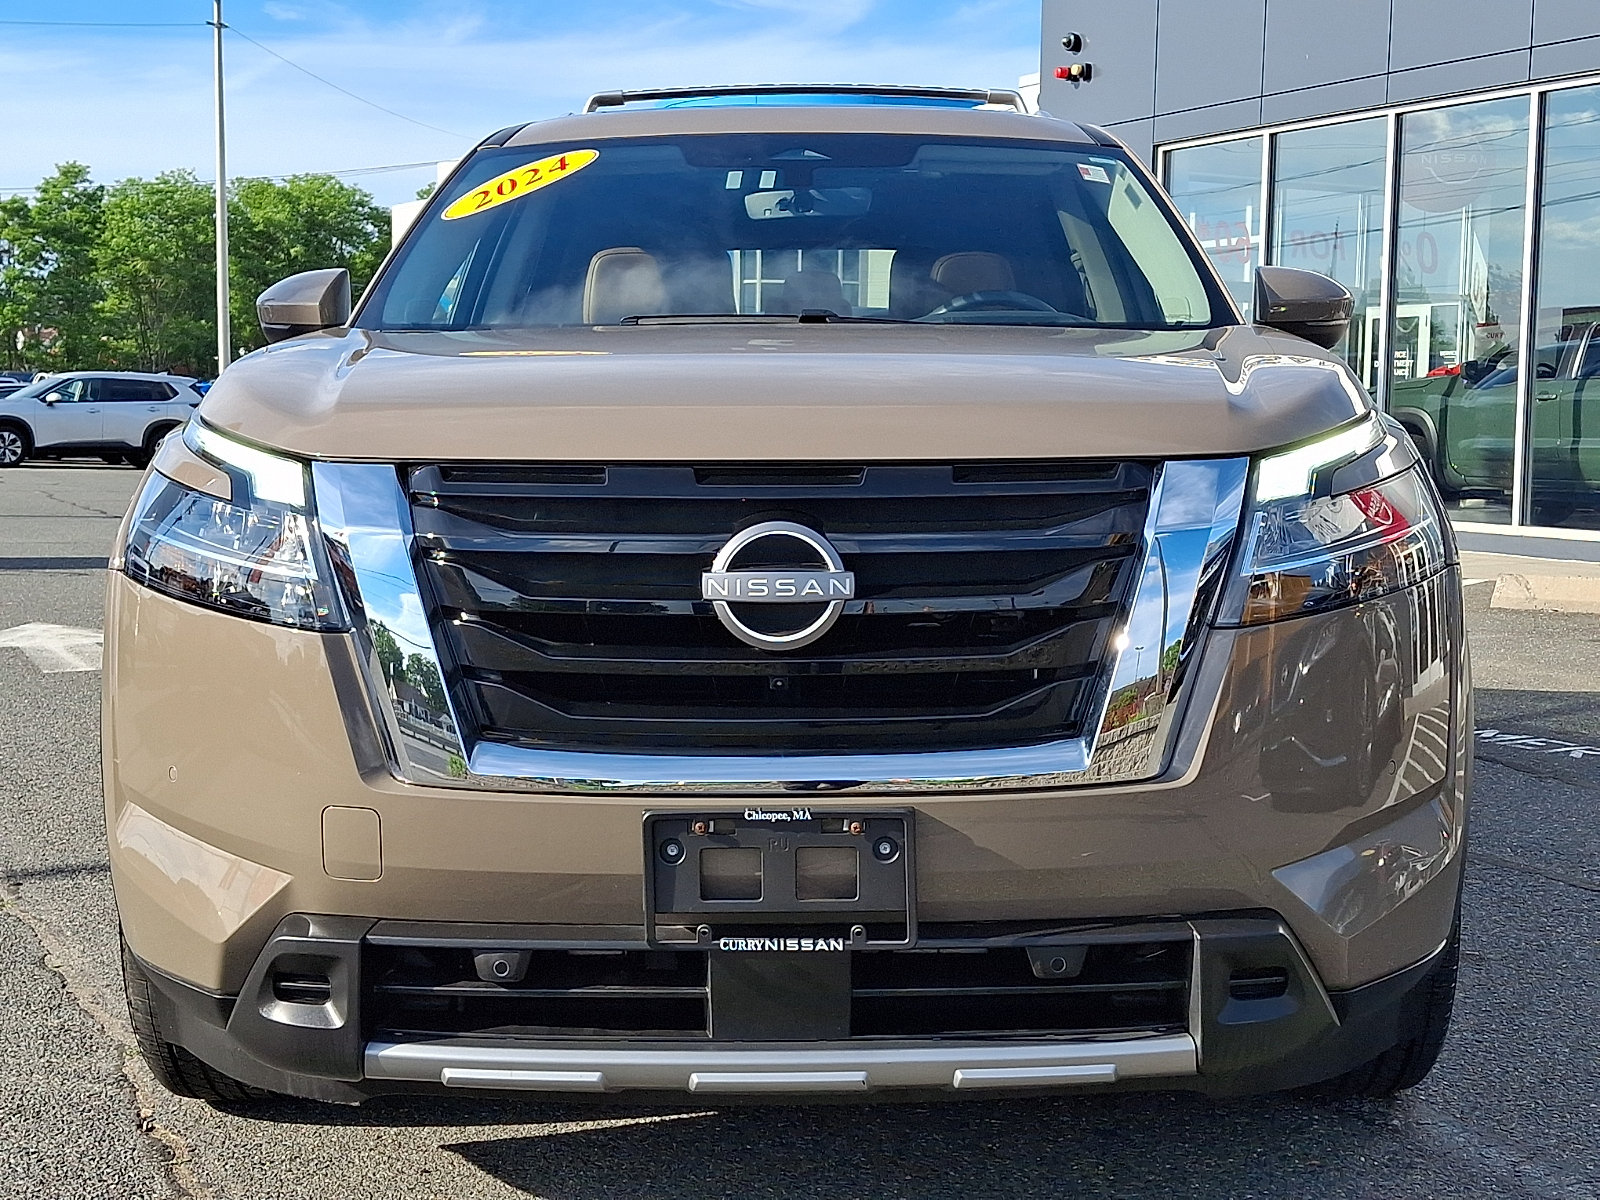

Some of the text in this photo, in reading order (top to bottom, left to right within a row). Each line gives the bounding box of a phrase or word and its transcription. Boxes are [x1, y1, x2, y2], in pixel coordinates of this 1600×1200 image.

[1421, 153, 1488, 165] NISSAN
[472, 155, 570, 210] 2024
[707, 577, 850, 597] NISSAN
[744, 808, 812, 822] Chicopee, MA
